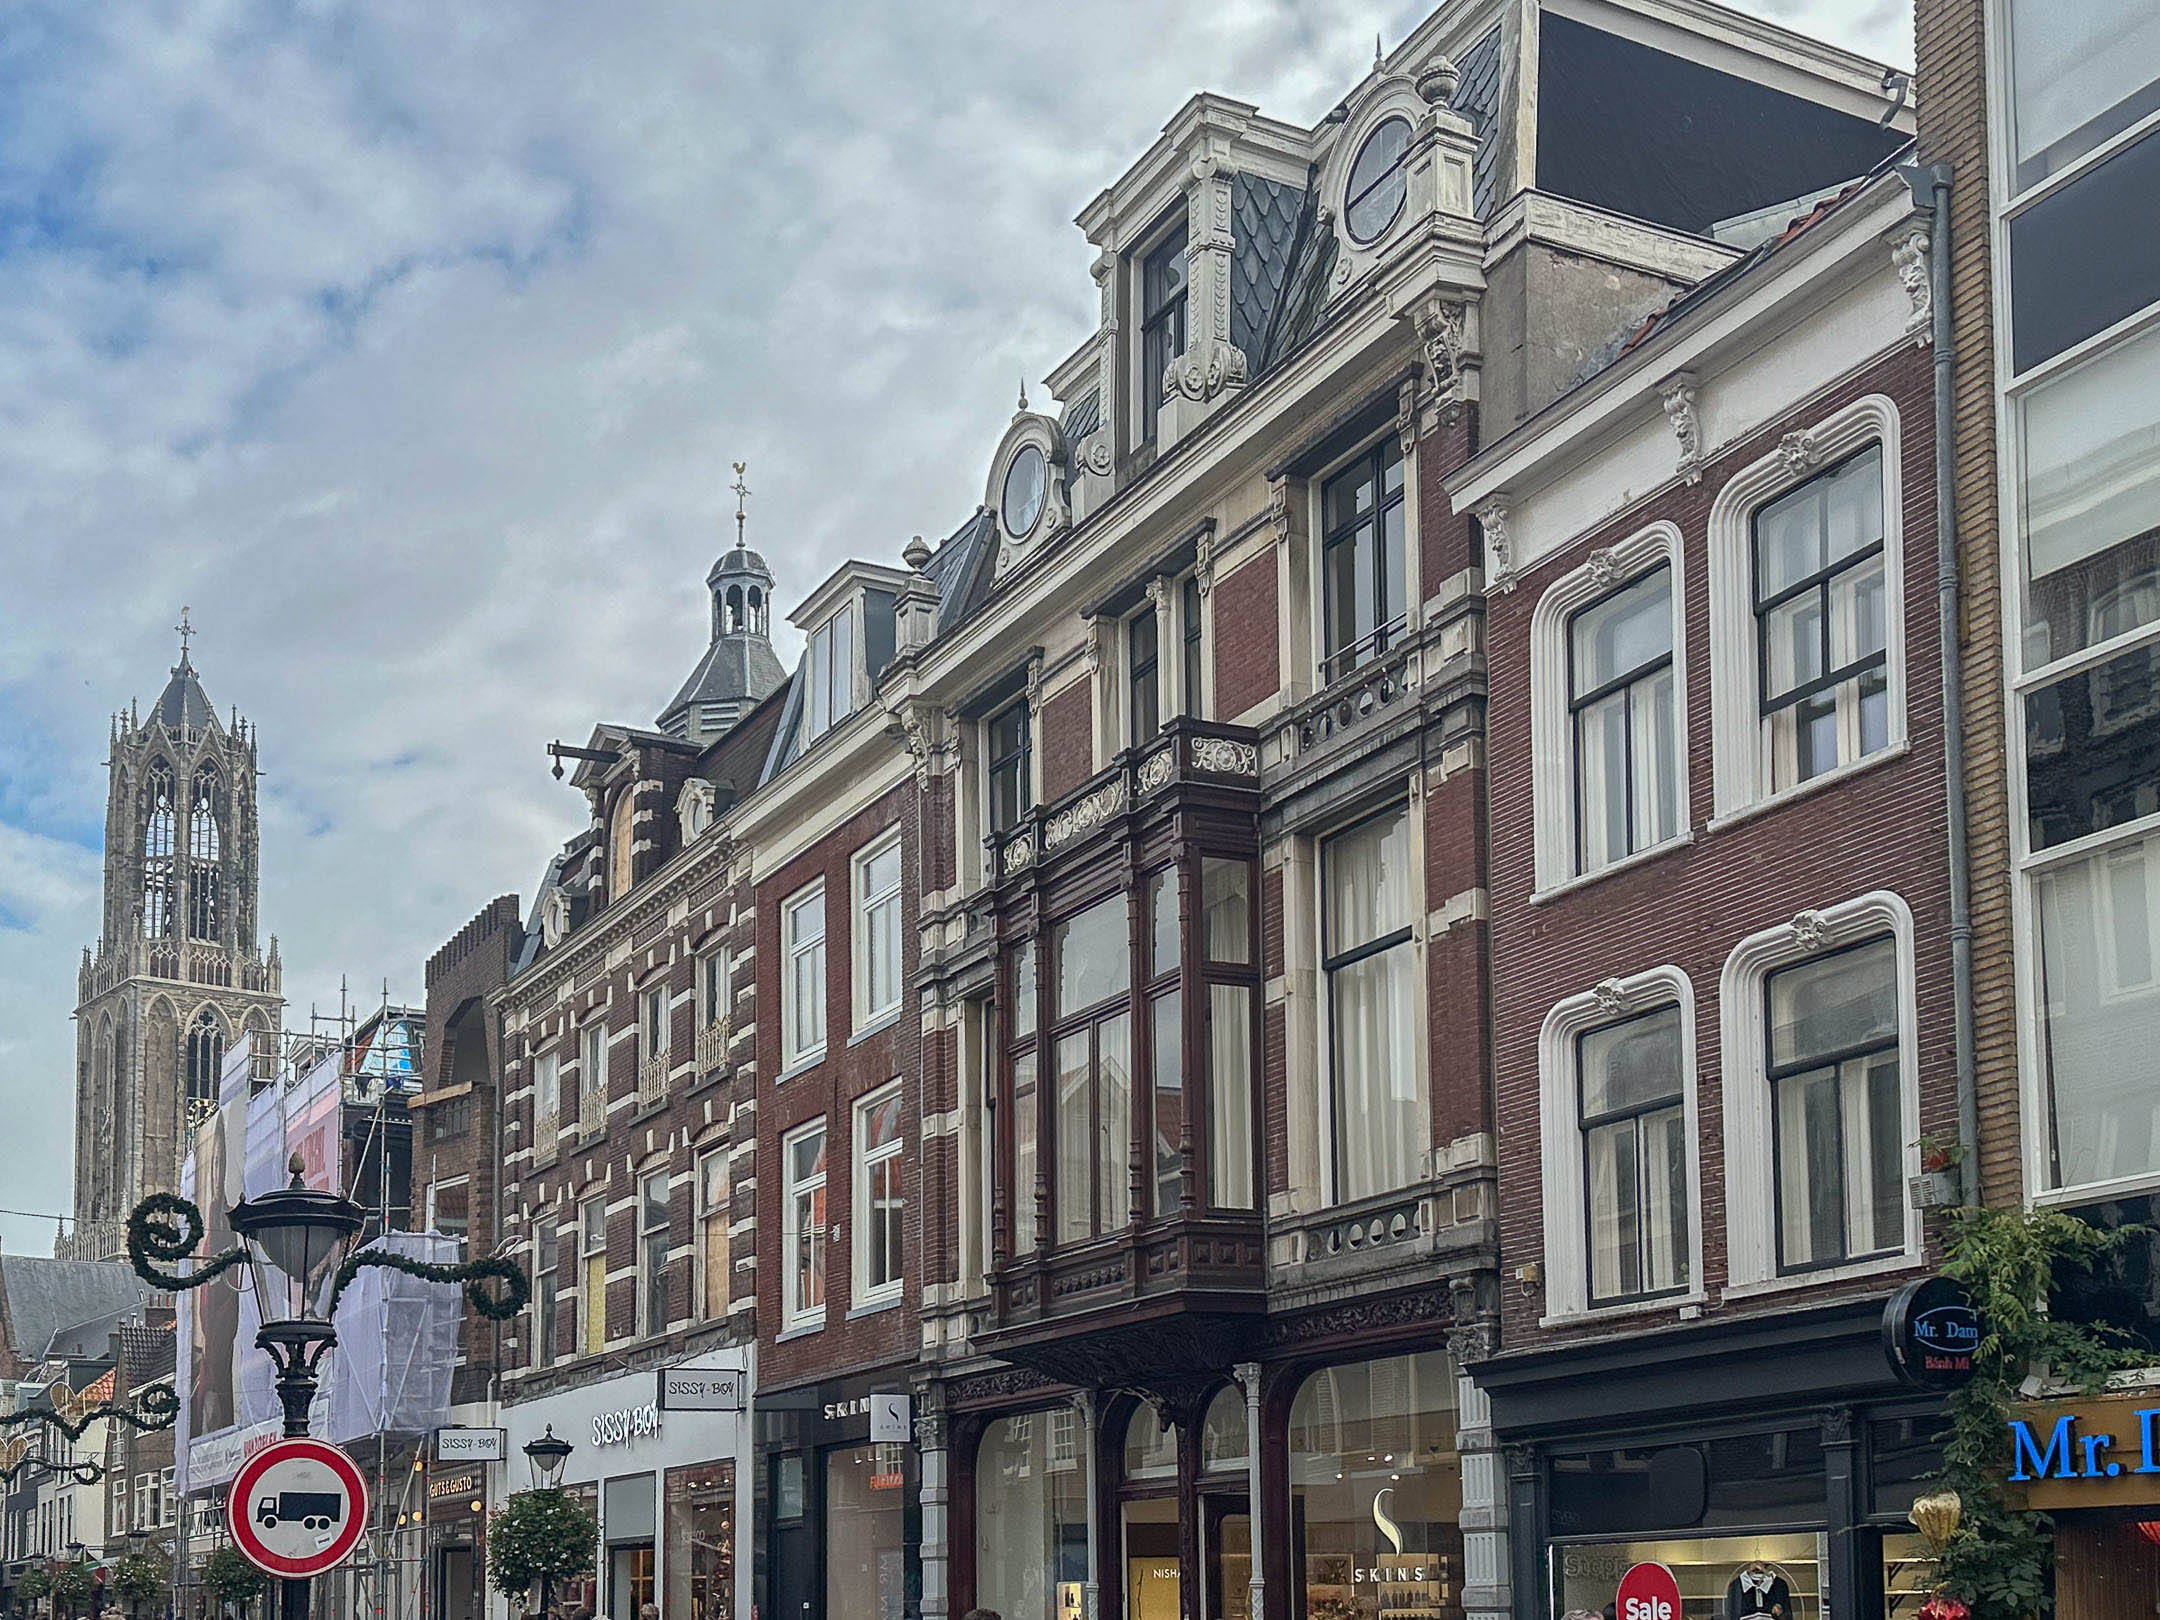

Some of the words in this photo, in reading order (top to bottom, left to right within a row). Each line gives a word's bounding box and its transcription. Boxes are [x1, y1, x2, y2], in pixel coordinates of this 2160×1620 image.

[1914, 1320, 1939, 1338] Mr.
[1946, 1321, 1978, 1338] Dam
[2008, 1415, 2120, 1482] Mr.
[1354, 1567, 1425, 1583] SKINS
[1625, 1596, 1672, 1620] Sale
